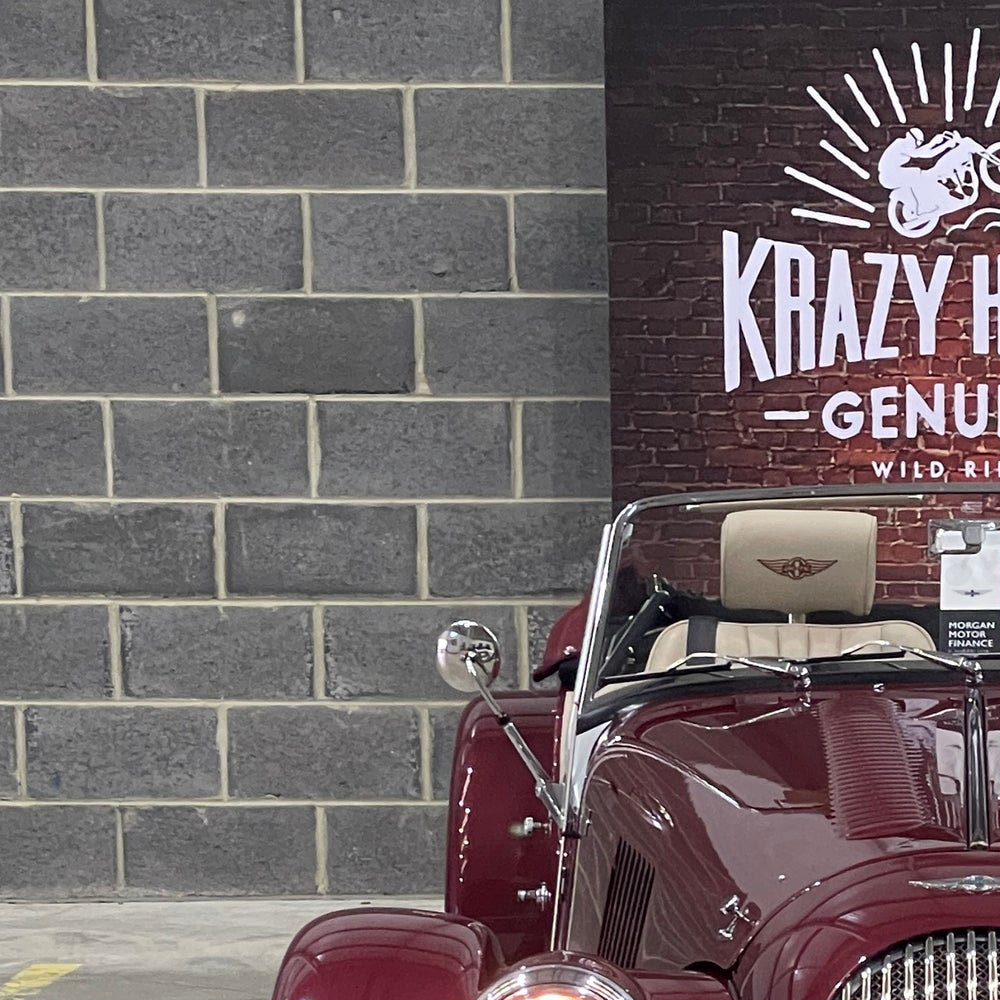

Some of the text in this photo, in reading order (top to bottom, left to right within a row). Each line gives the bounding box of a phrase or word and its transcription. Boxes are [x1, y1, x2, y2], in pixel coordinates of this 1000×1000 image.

[723, 229, 953, 393] KRAZY
[871, 461, 944, 479] WILD
[948, 621, 995, 630] MORGAN
[948, 630, 986, 639] MOTOR
[948, 639, 994, 648] FINANCE
